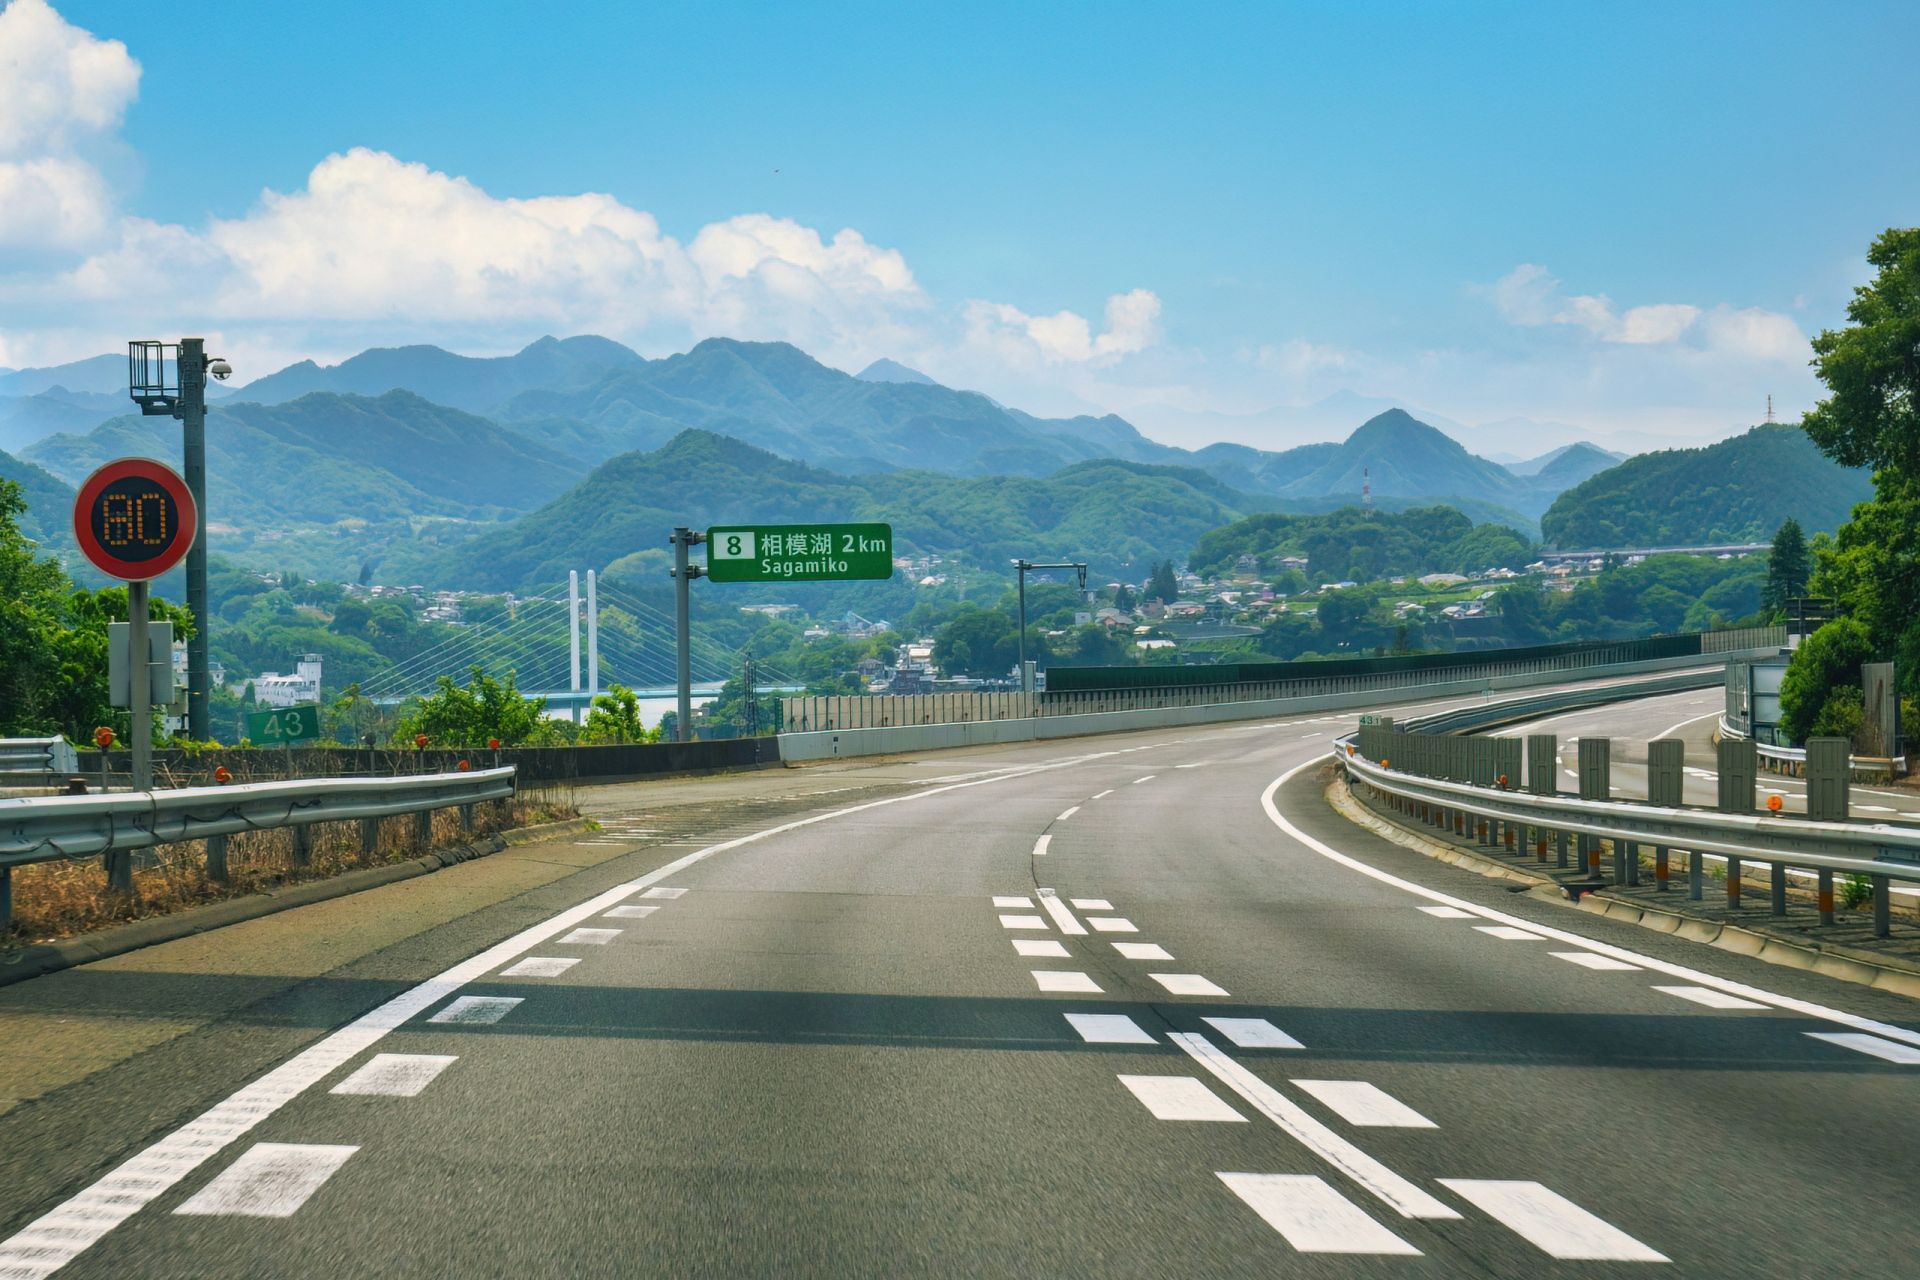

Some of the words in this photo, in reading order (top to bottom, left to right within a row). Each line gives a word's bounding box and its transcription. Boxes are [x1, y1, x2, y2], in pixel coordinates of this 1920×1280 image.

[103, 493, 166, 545] 80
[727, 535, 742, 556] 8
[761, 533, 832, 556] 相模湖
[761, 558, 848, 577] Sagamiko
[264, 712, 304, 738] 43
